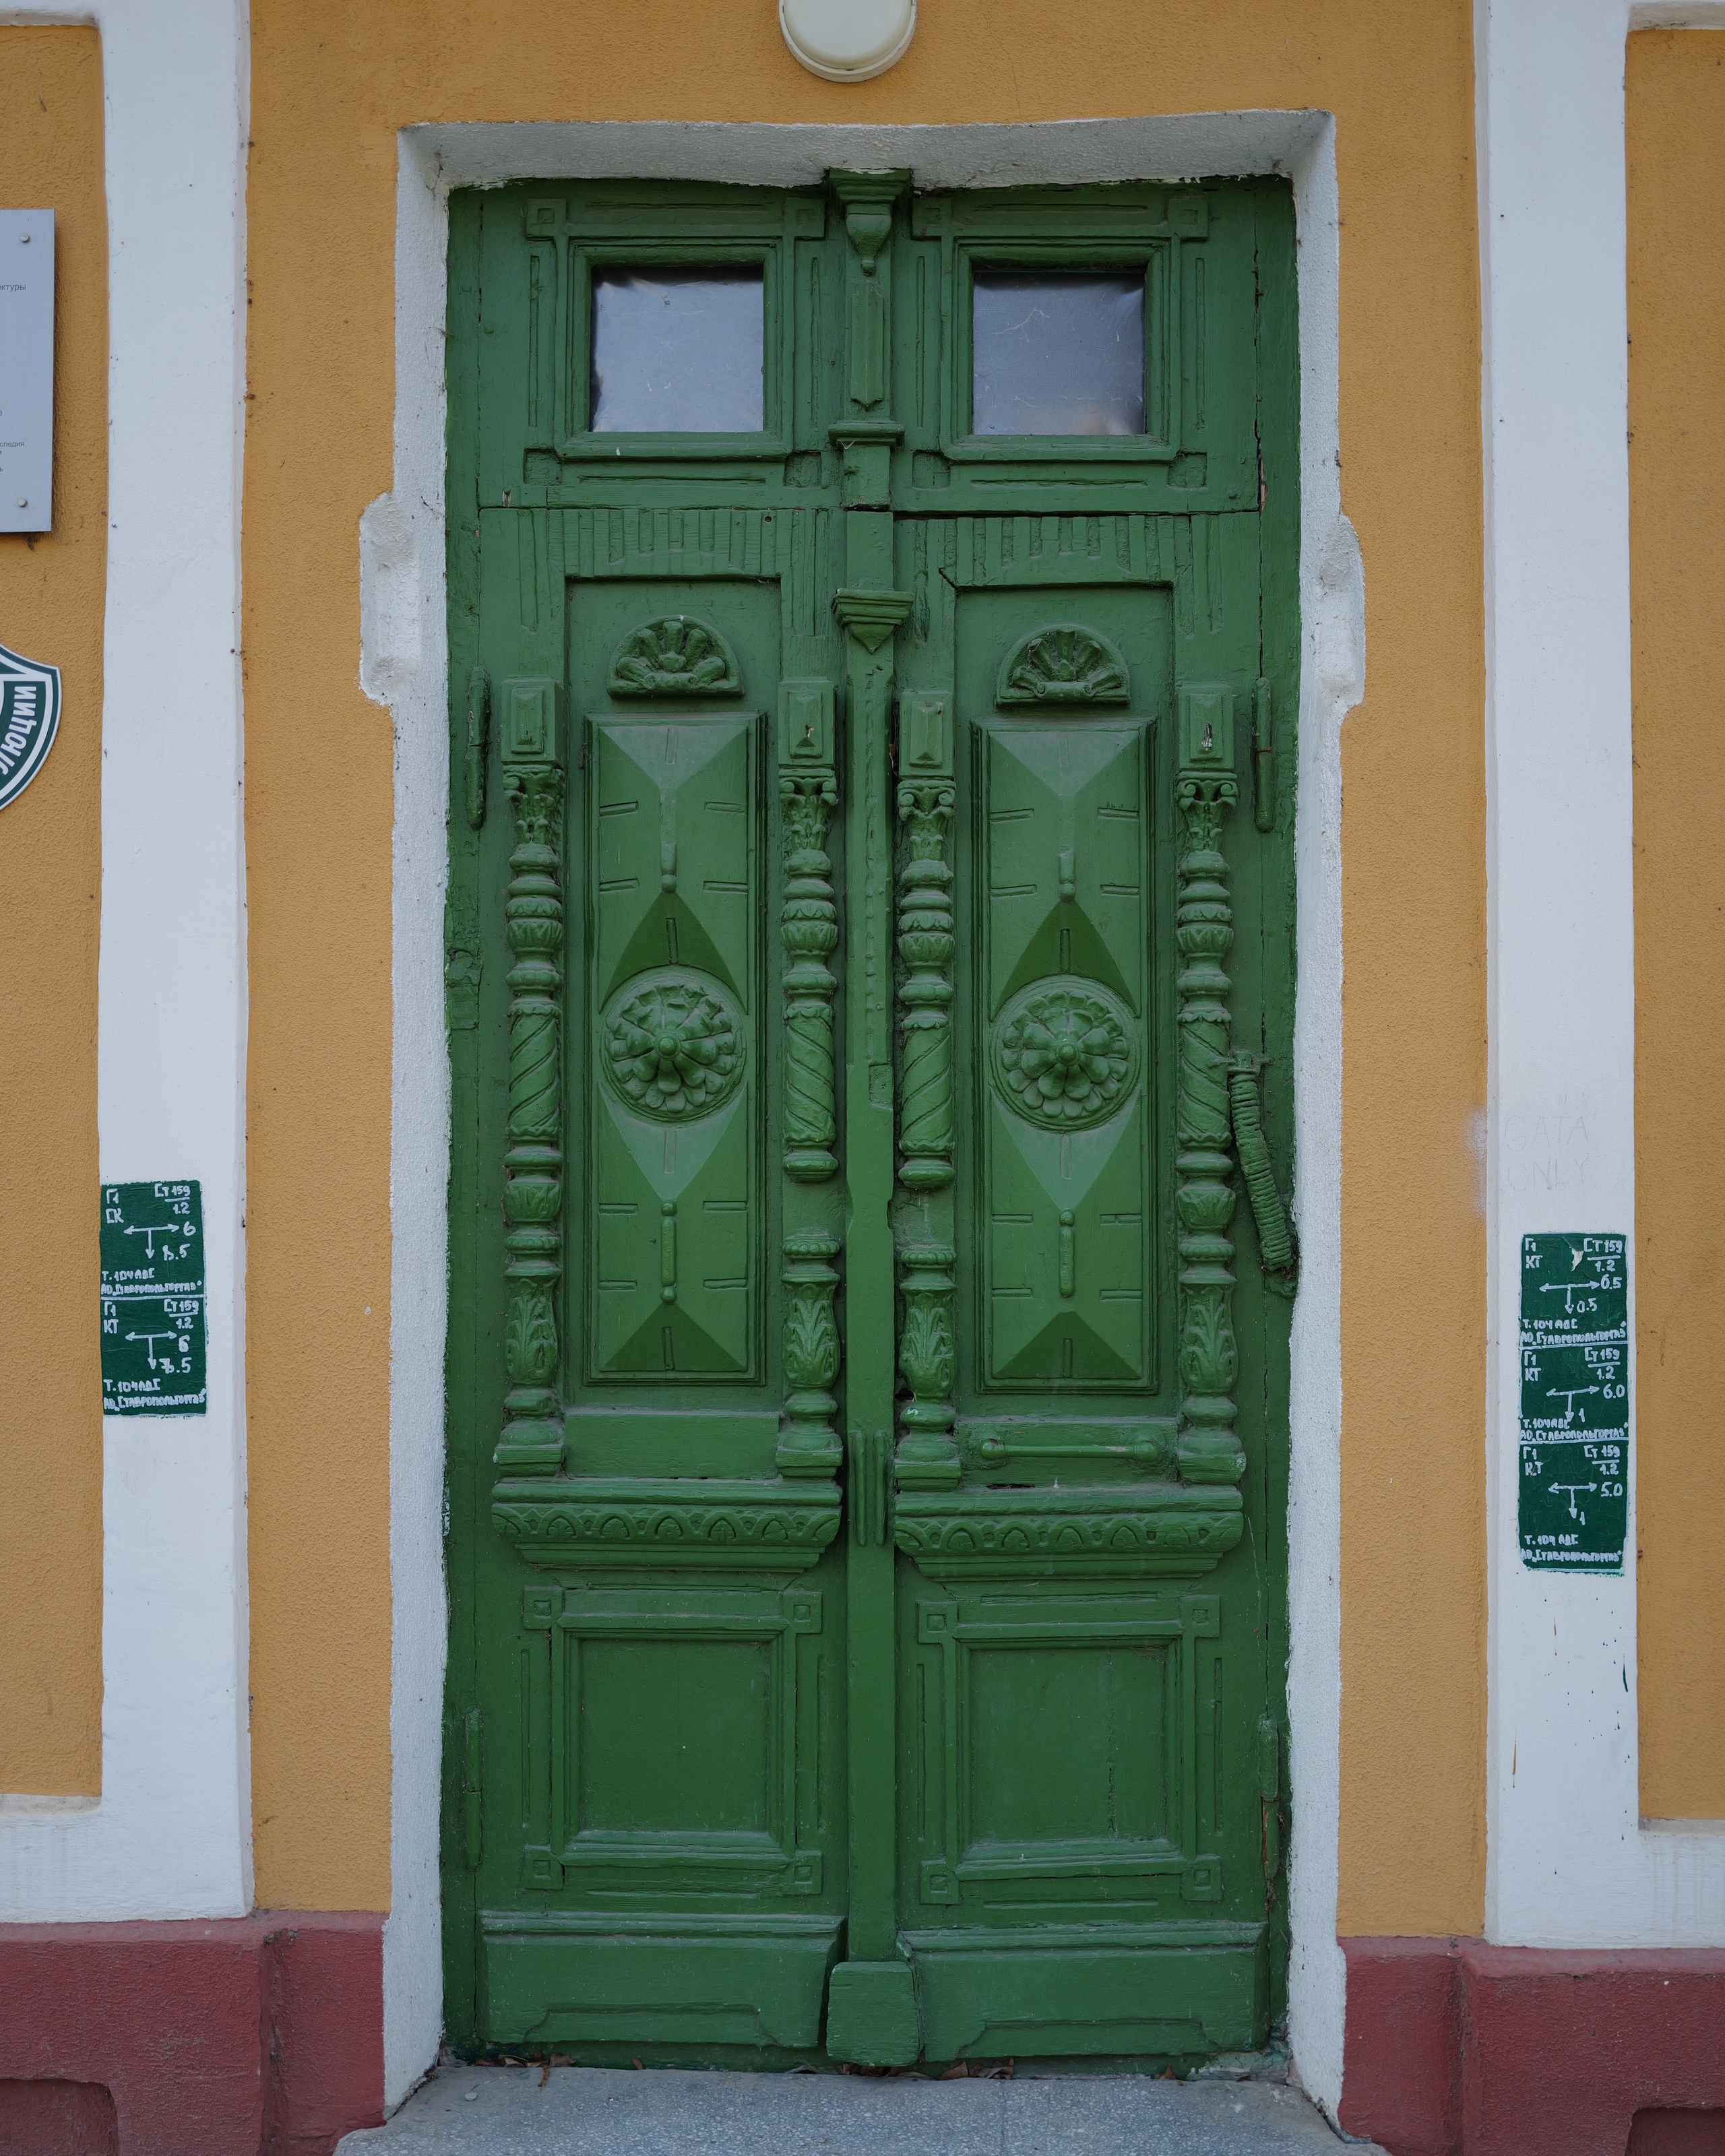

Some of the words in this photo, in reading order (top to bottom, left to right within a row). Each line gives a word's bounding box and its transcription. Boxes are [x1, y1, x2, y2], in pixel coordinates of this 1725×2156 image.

[0, 284, 26, 292] ктуры
[171, 1185, 191, 1197] 159
[172, 1201, 190, 1214] 1.2
[183, 1221, 196, 1236] 6
[1604, 1240, 1623, 1253] 159
[1595, 1259, 1616, 1272] 1.2
[1600, 1274, 1623, 1290] 6.5
[179, 1300, 199, 1313] 159
[1576, 1298, 1598, 1313] 0.5
[176, 1317, 194, 1329] 1.2
[179, 1335, 191, 1352] 6
[1600, 1348, 1620, 1360] 159
[1596, 1366, 1616, 1381] 1.2
[1603, 1383, 1625, 1399] 6.0
[1578, 1408, 1586, 1422] 1
[1601, 1445, 1621, 1457] 159
[1599, 1463, 1619, 1476] 1.2
[1600, 1482, 1623, 1497] 5.0
[1579, 1511, 1586, 1525] 1
